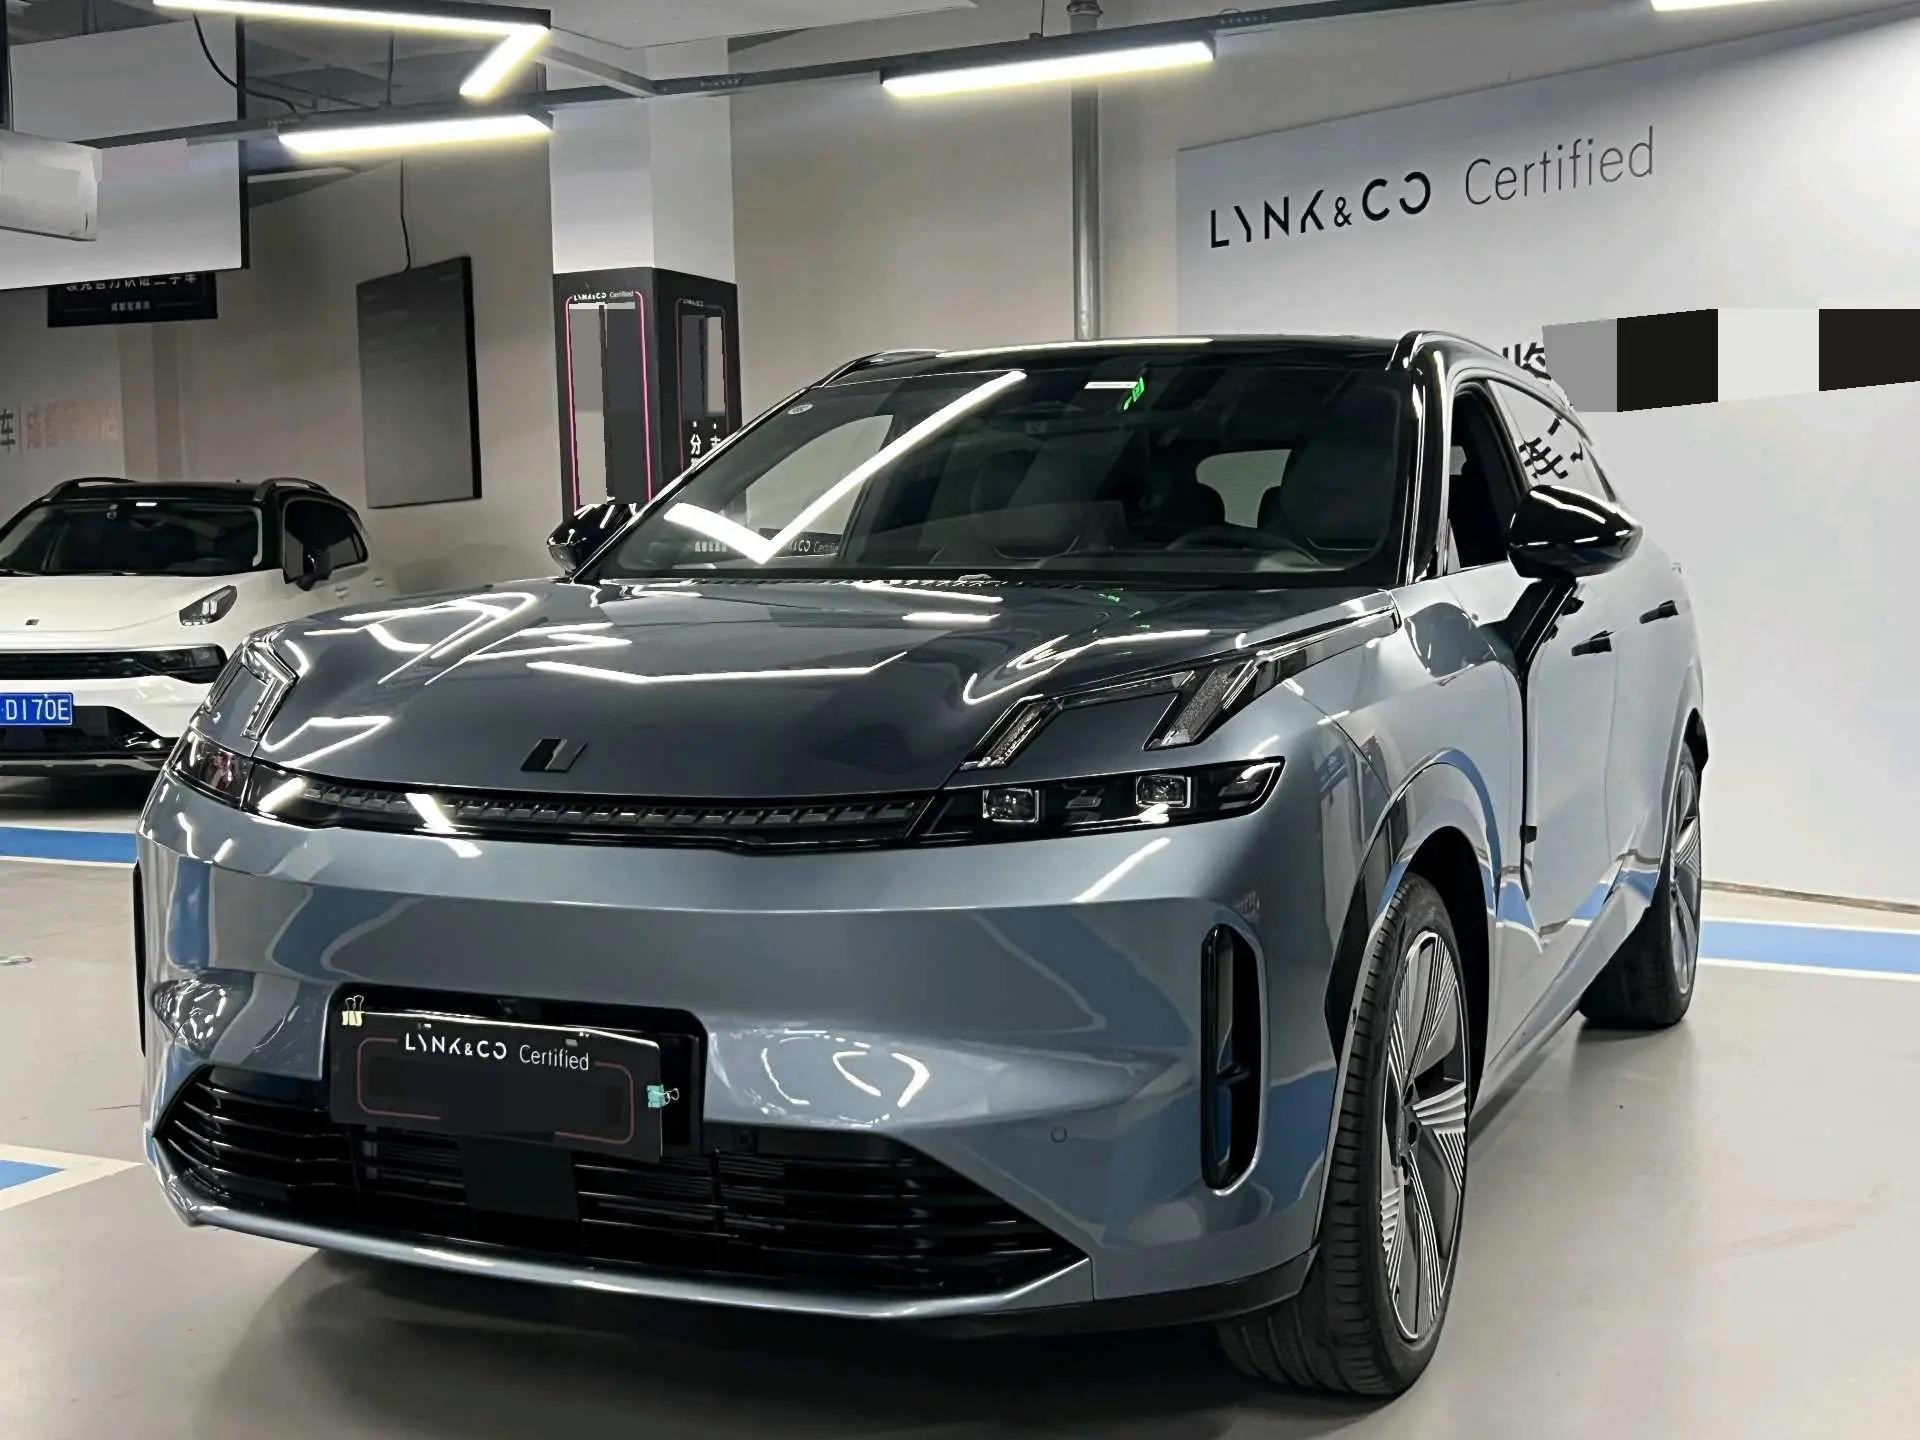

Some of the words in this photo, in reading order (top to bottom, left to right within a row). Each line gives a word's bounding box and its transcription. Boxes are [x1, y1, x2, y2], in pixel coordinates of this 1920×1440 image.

[1210, 171, 1431, 248] LYNK&CO
[1465, 125, 1653, 205] Certified
[405, 1032, 507, 1060] LYNK&CO
[519, 1044, 589, 1071] Certified
